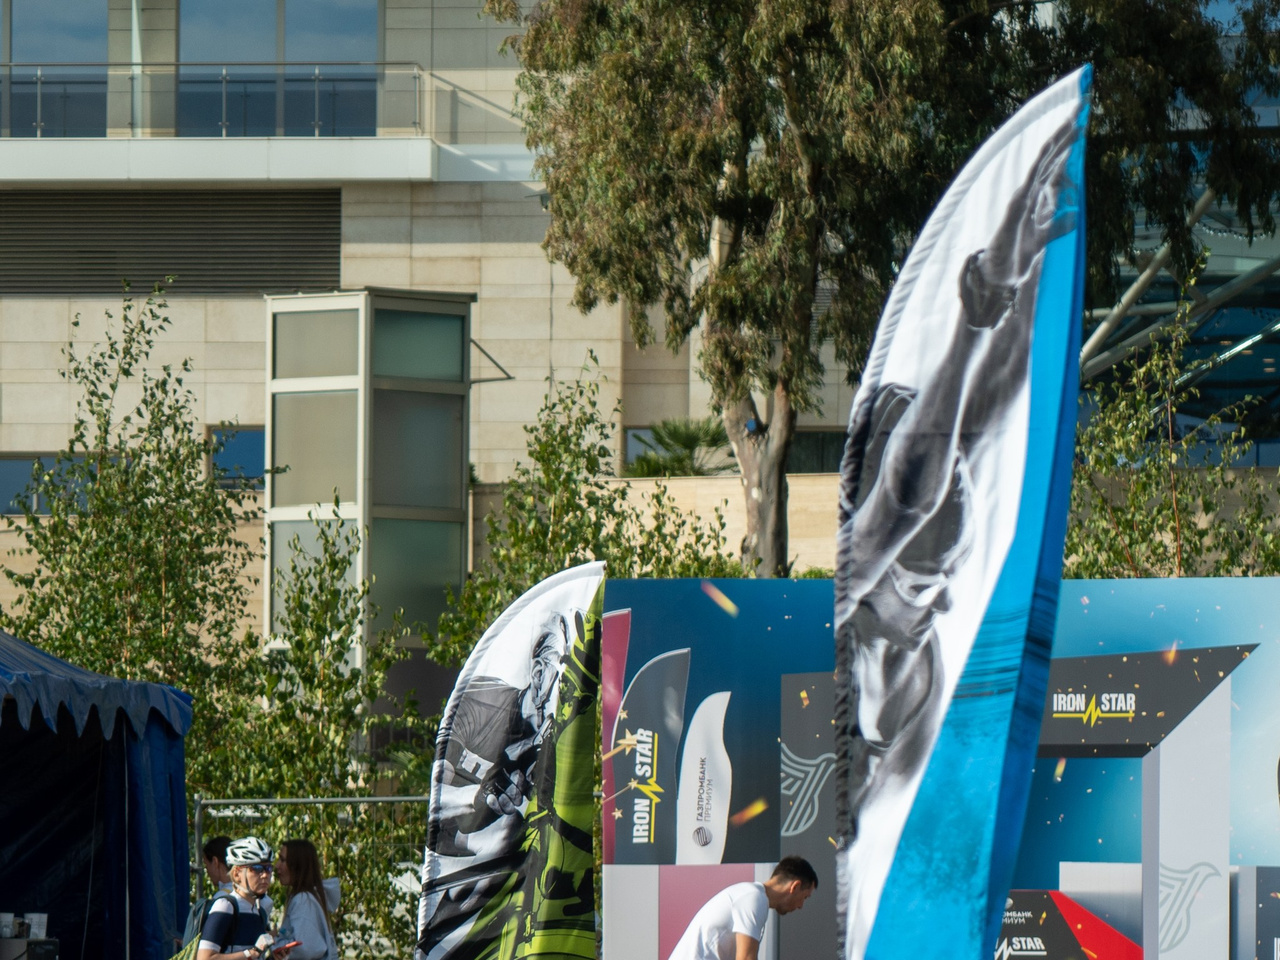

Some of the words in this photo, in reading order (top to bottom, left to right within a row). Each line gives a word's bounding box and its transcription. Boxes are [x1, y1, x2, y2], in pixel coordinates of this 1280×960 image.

[1053, 693, 1086, 712] IRON
[1101, 693, 1136, 712] STAR
[635, 728, 653, 777] STAR
[696, 757, 707, 822] ГАЗПРОМБАНК
[704, 778, 713, 822] ПРЕМИУМ
[632, 798, 650, 844] IRON
[1012, 936, 1046, 950] STAR
